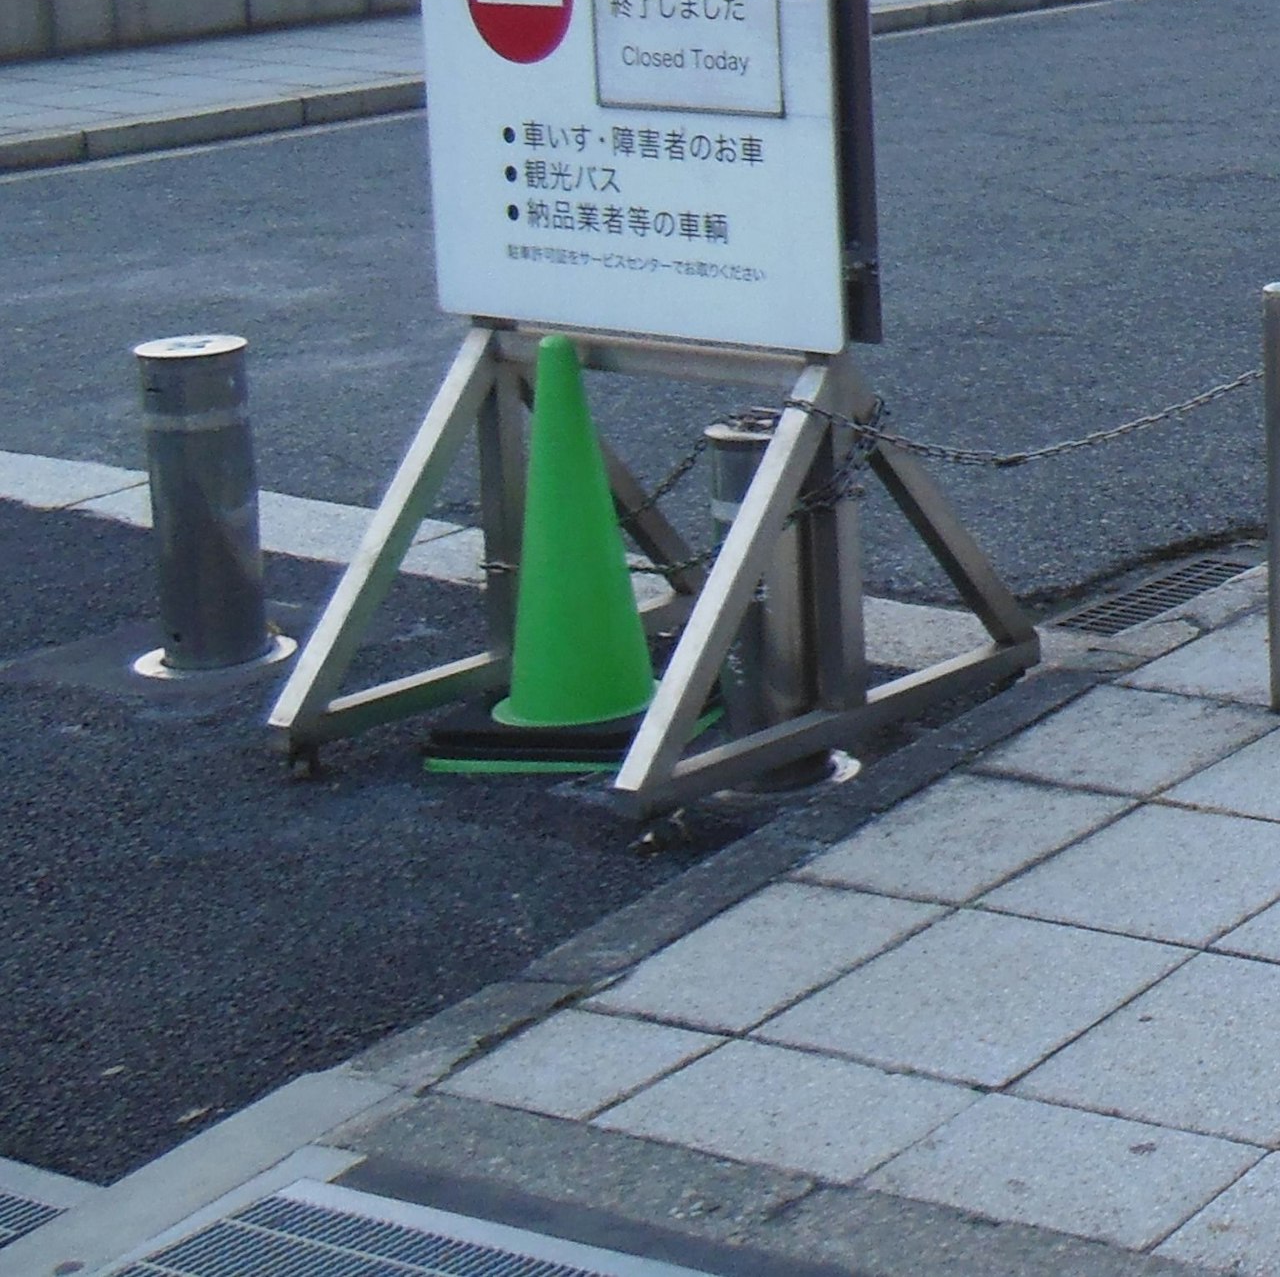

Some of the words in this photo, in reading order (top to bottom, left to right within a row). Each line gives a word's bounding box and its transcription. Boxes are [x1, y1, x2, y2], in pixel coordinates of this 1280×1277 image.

[621, 45, 686, 69] Closed
[690, 48, 750, 77] Today
[522, 119, 766, 167] 車いす・障害者のお車
[524, 158, 622, 194] 観光バス
